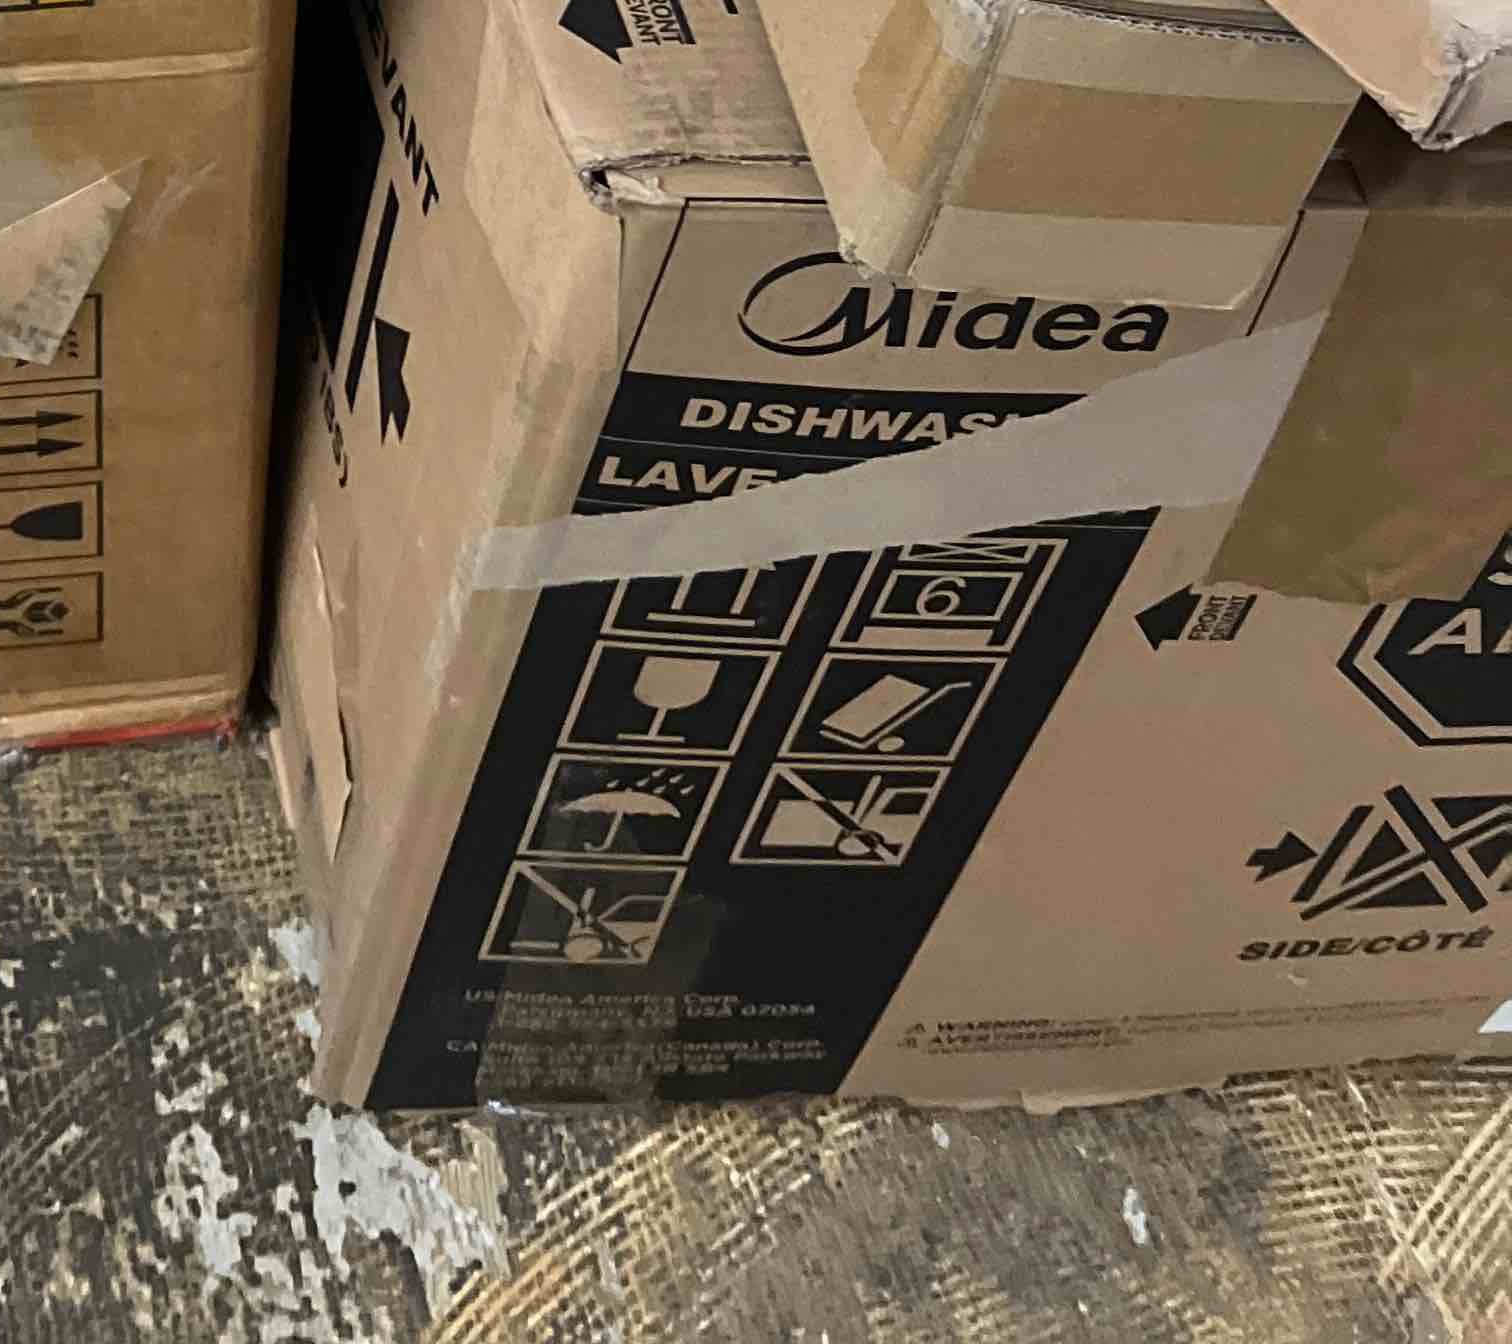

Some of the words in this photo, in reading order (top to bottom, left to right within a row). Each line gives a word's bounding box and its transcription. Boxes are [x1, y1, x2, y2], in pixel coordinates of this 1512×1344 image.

[773, 280, 1171, 355] Midea
[679, 397, 1024, 443] DISHWAS
[914, 575, 967, 617] 6
[1236, 925, 1495, 961] SIDE/CÔTÉ
